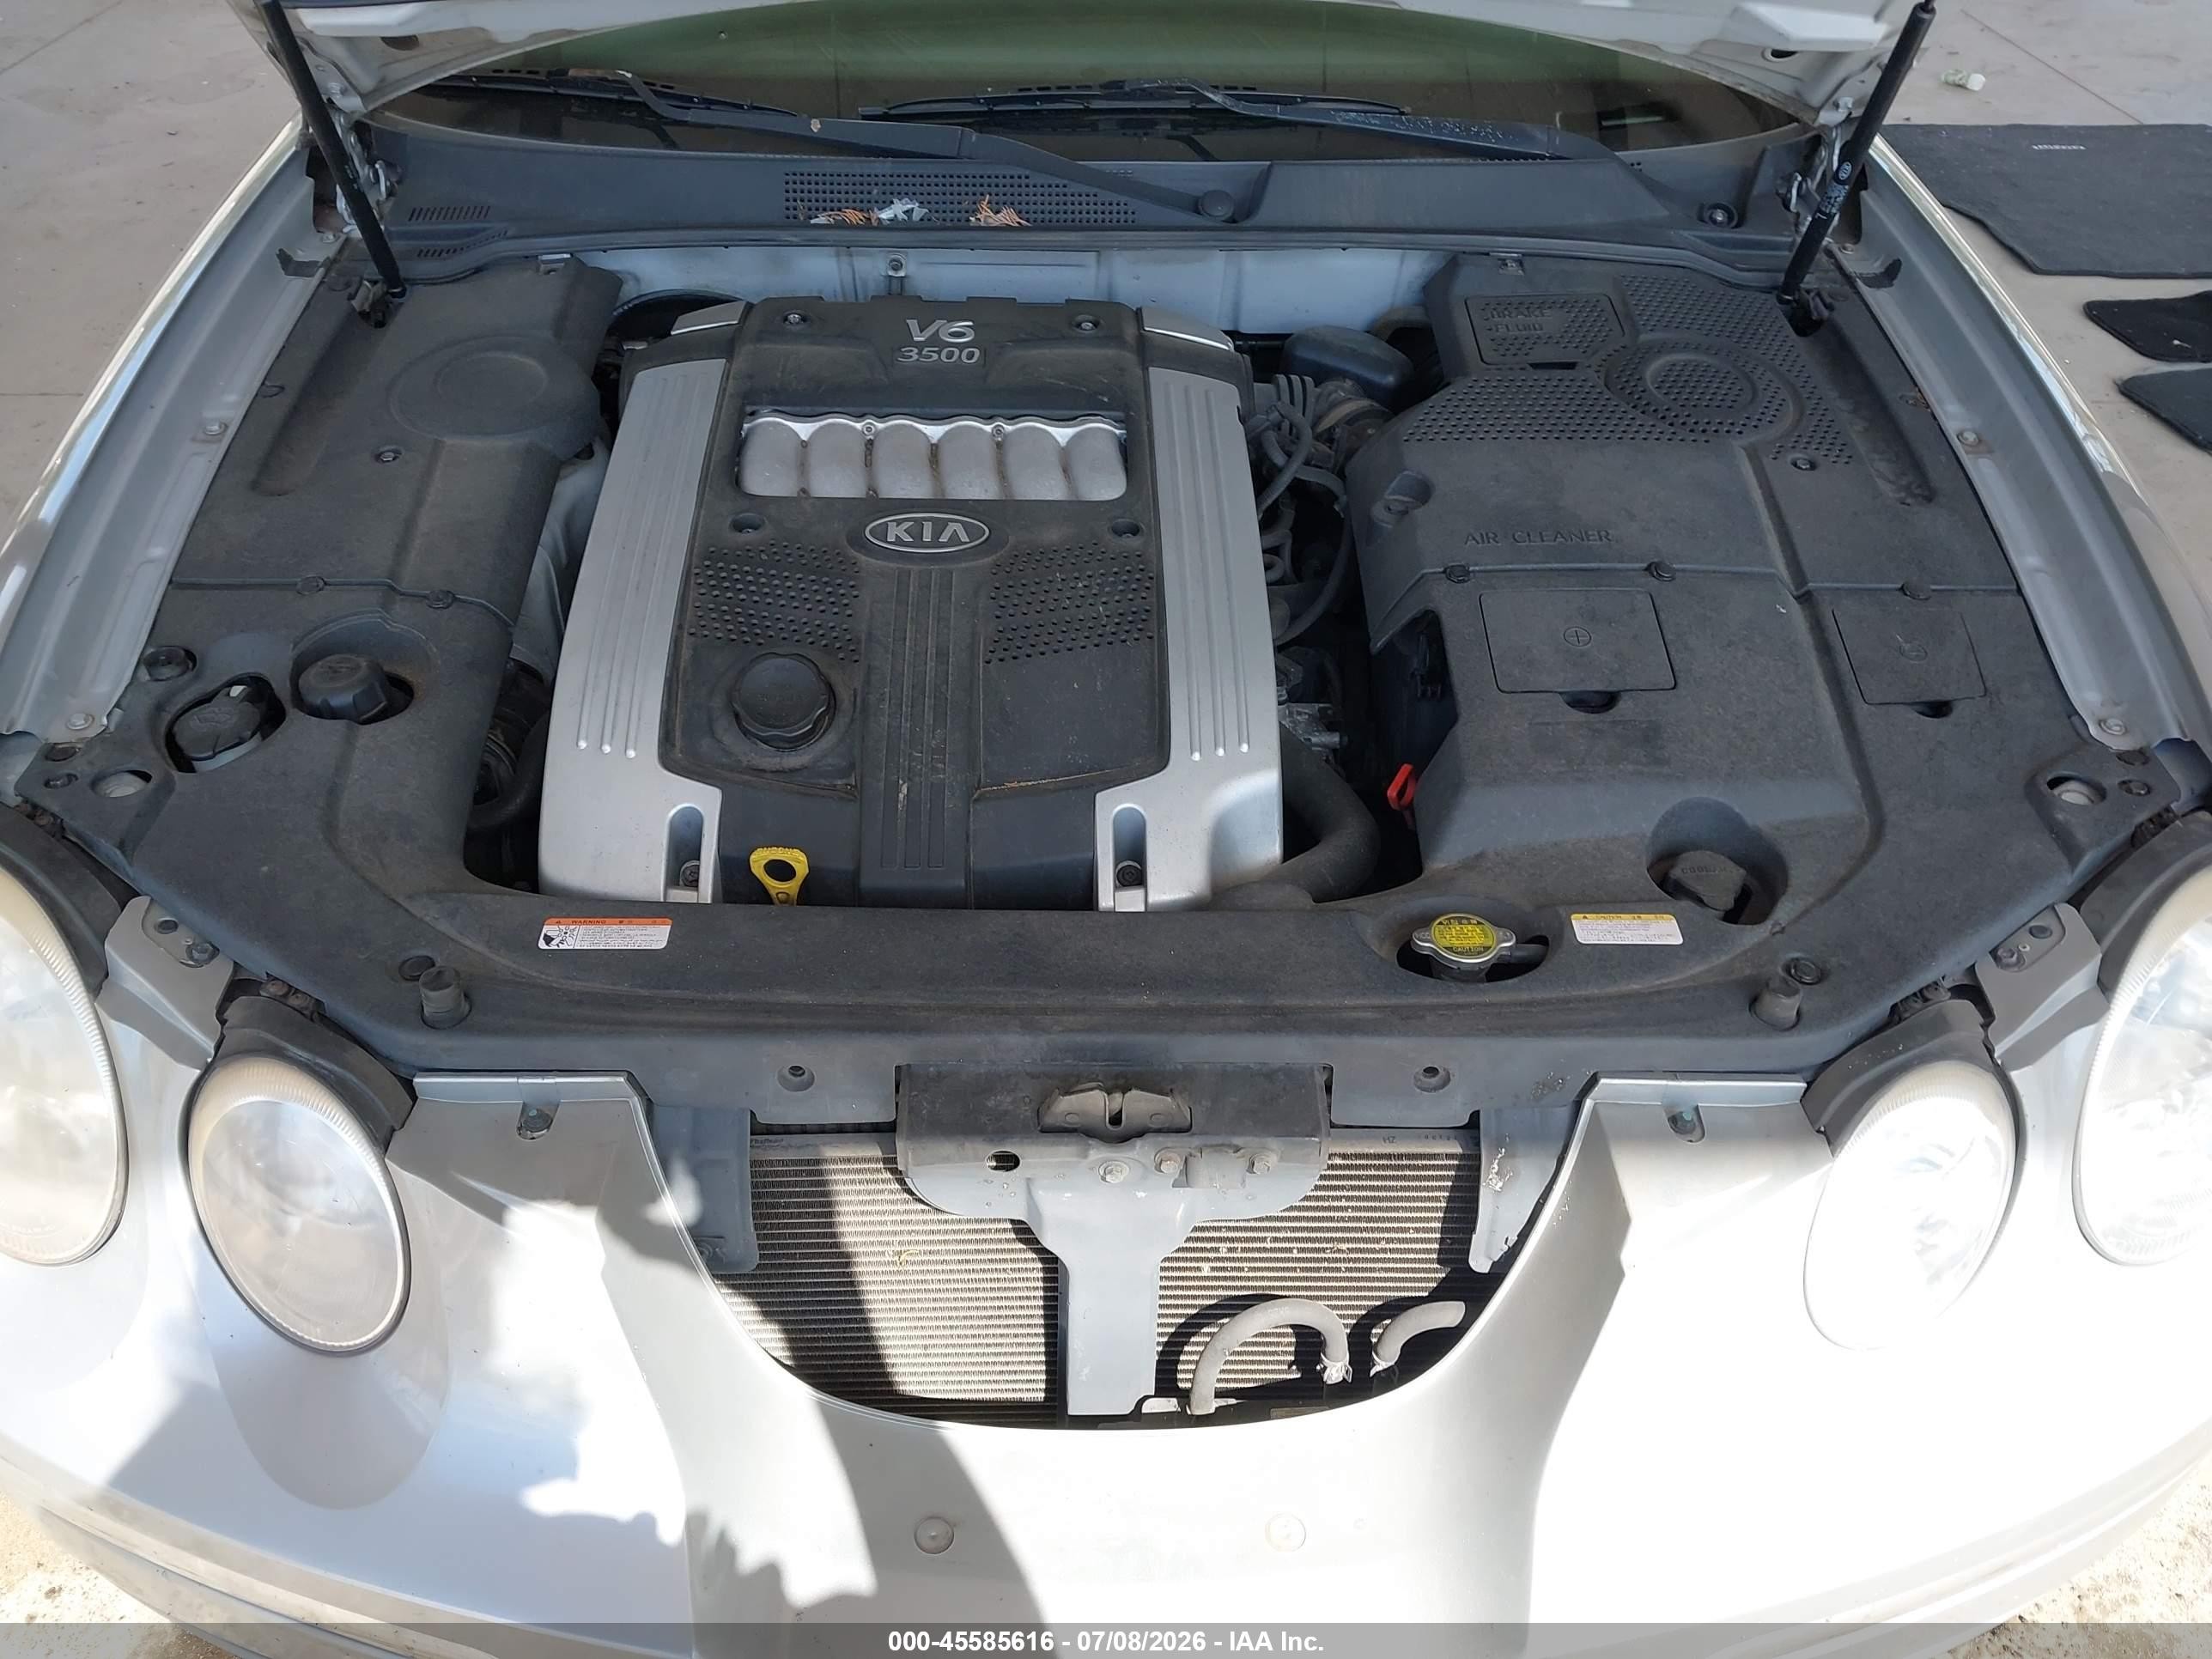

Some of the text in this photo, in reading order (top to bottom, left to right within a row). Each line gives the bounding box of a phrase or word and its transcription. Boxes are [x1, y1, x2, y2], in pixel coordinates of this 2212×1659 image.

[1490, 308, 1552, 319] BRAKE
[906, 319, 975, 343] V6
[1494, 323, 1544, 333] FLUID
[897, 347, 980, 363] 3500
[886, 521, 970, 542] KIA
[1464, 529, 1612, 544] AIR CLEANER
